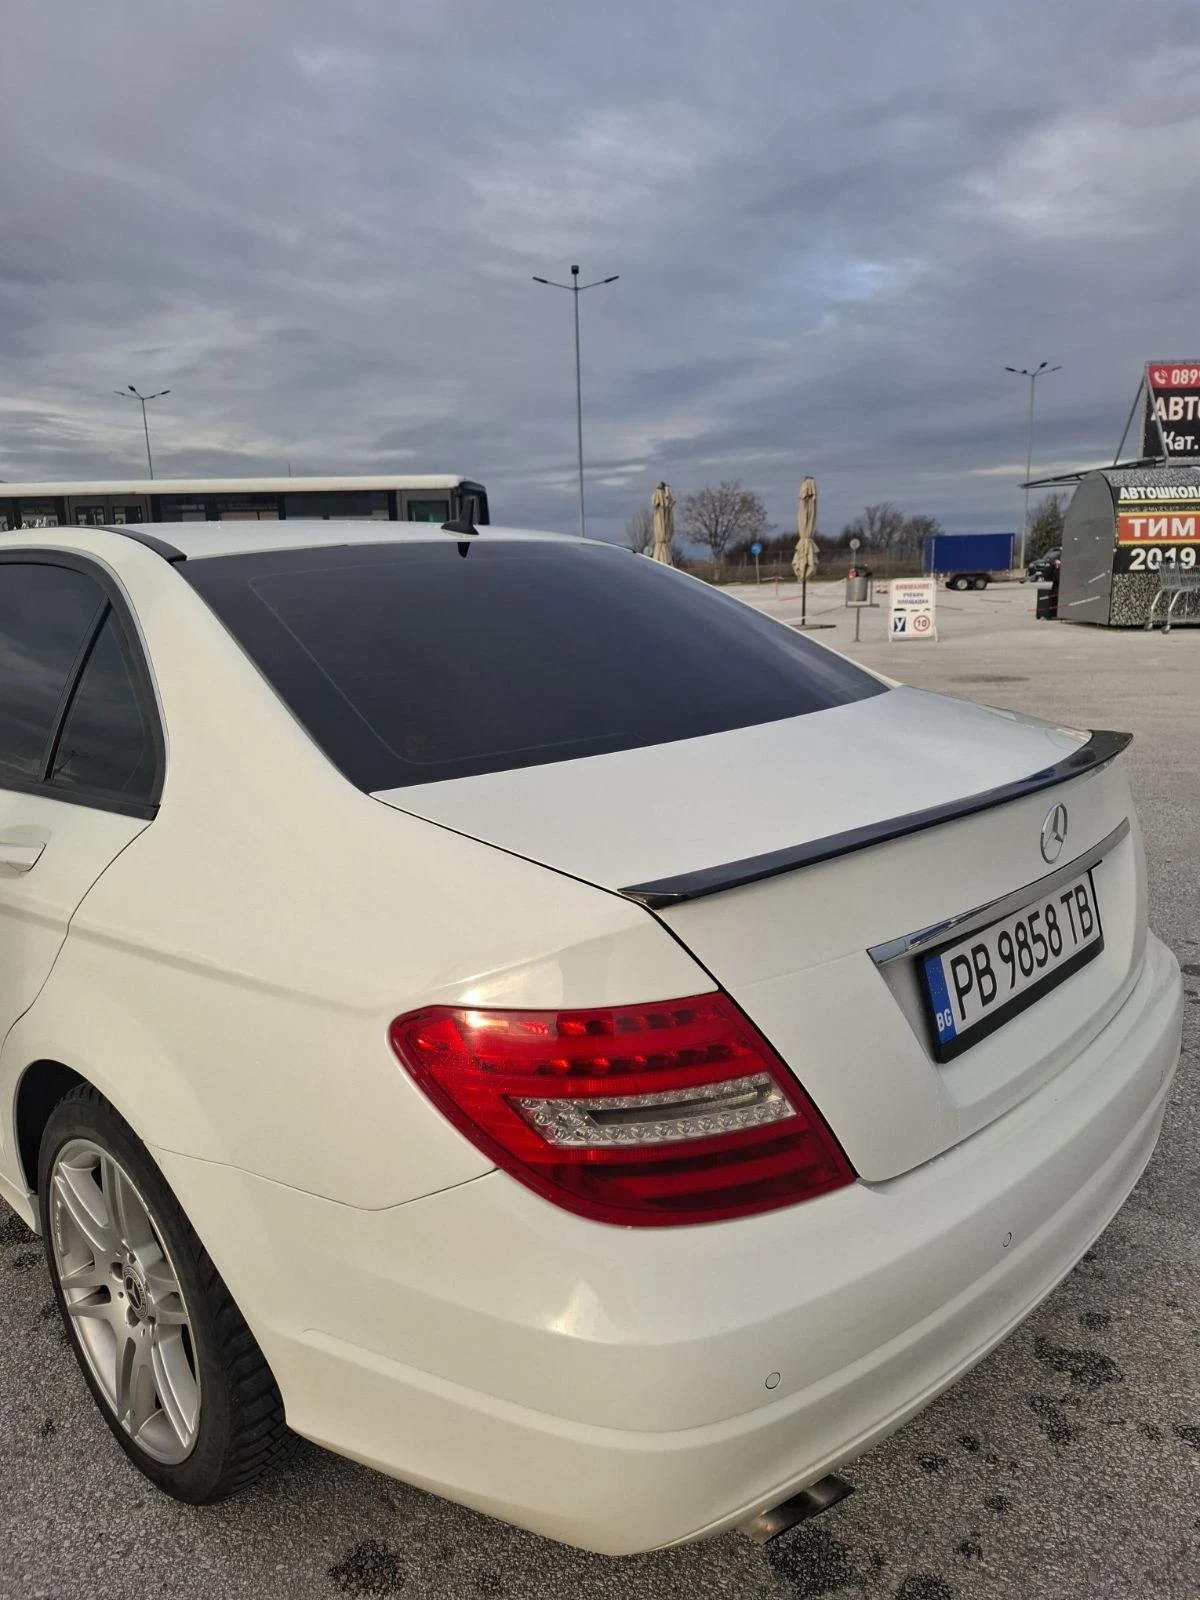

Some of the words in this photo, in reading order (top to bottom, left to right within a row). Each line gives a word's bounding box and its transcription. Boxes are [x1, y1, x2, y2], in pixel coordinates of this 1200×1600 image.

[1171, 369, 1200, 385] 089
[1151, 396, 1200, 421] АВТ
[1163, 431, 1199, 450] Кат.
[1120, 486, 1200, 499] АВТОШКОЛ
[1128, 517, 1195, 538] ТИМ
[1129, 547, 1196, 570] 2019
[917, 619, 927, 627] 10
[950, 943, 997, 1021] PB
[998, 904, 1063, 990] 9858
[1060, 884, 1094, 945] TB
[936, 1008, 952, 1032] BG
